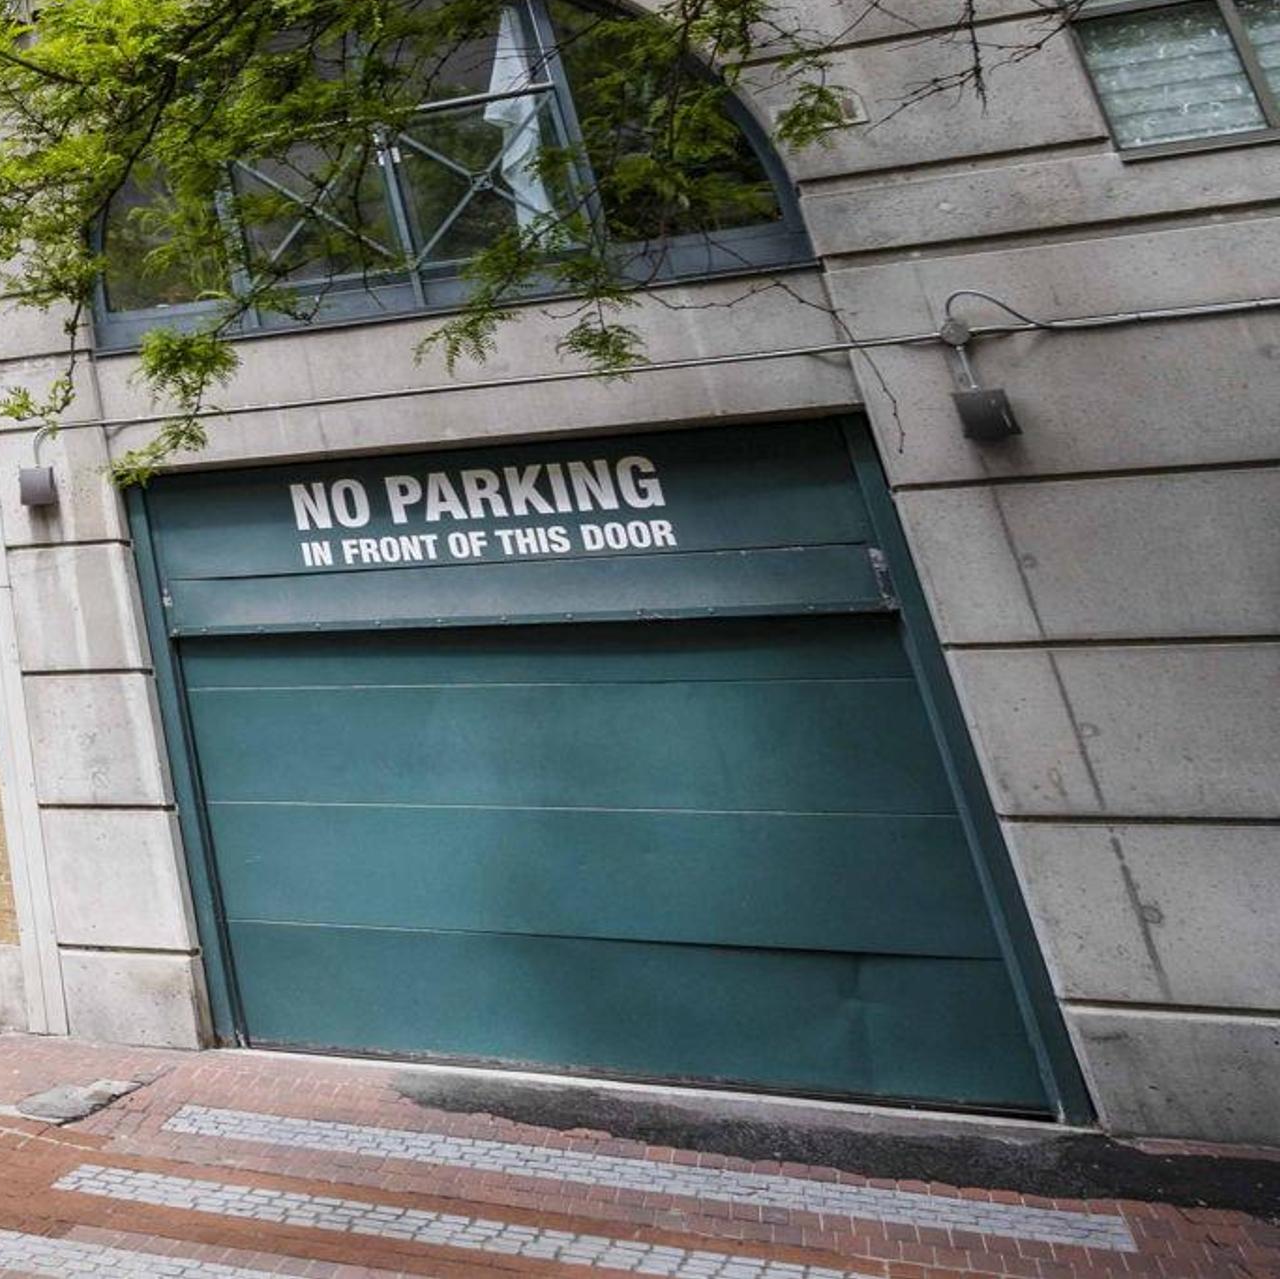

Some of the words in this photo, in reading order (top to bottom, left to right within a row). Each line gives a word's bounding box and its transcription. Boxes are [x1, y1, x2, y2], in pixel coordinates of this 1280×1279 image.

[289, 477, 371, 531] NO
[383, 455, 667, 524] PARKING
[300, 540, 333, 568] IN
[341, 532, 438, 566] FRONT
[447, 528, 488, 559] OF
[494, 524, 572, 557] THIS
[580, 518, 678, 551] DOOR
